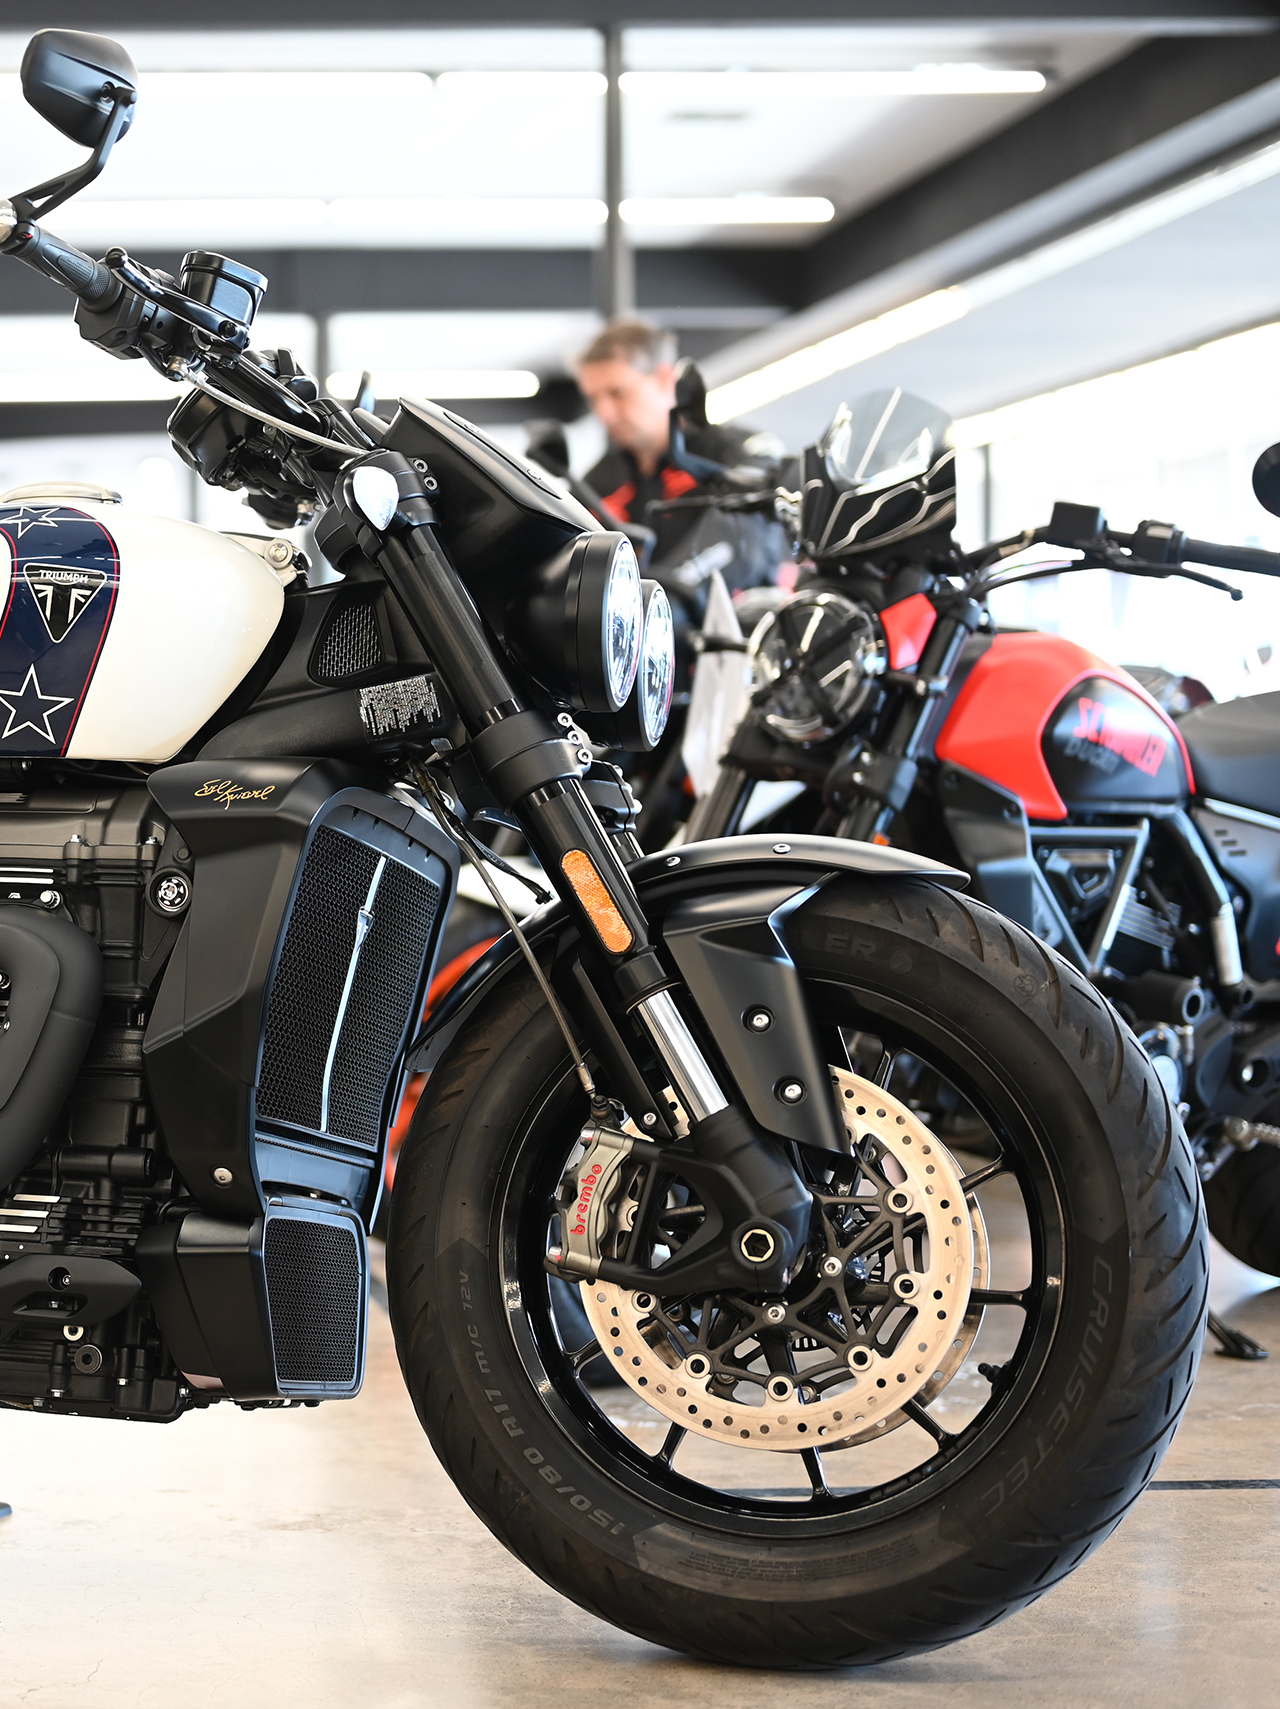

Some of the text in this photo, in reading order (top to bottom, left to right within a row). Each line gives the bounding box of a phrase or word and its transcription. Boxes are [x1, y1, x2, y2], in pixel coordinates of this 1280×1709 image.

[39, 570, 89, 583] TRIUMPH
[570, 1164, 602, 1235] brembo
[484, 1388, 524, 1438] R17
[981, 1255, 1113, 1517] CRUISETEC
[523, 1446, 625, 1535] 150/80
